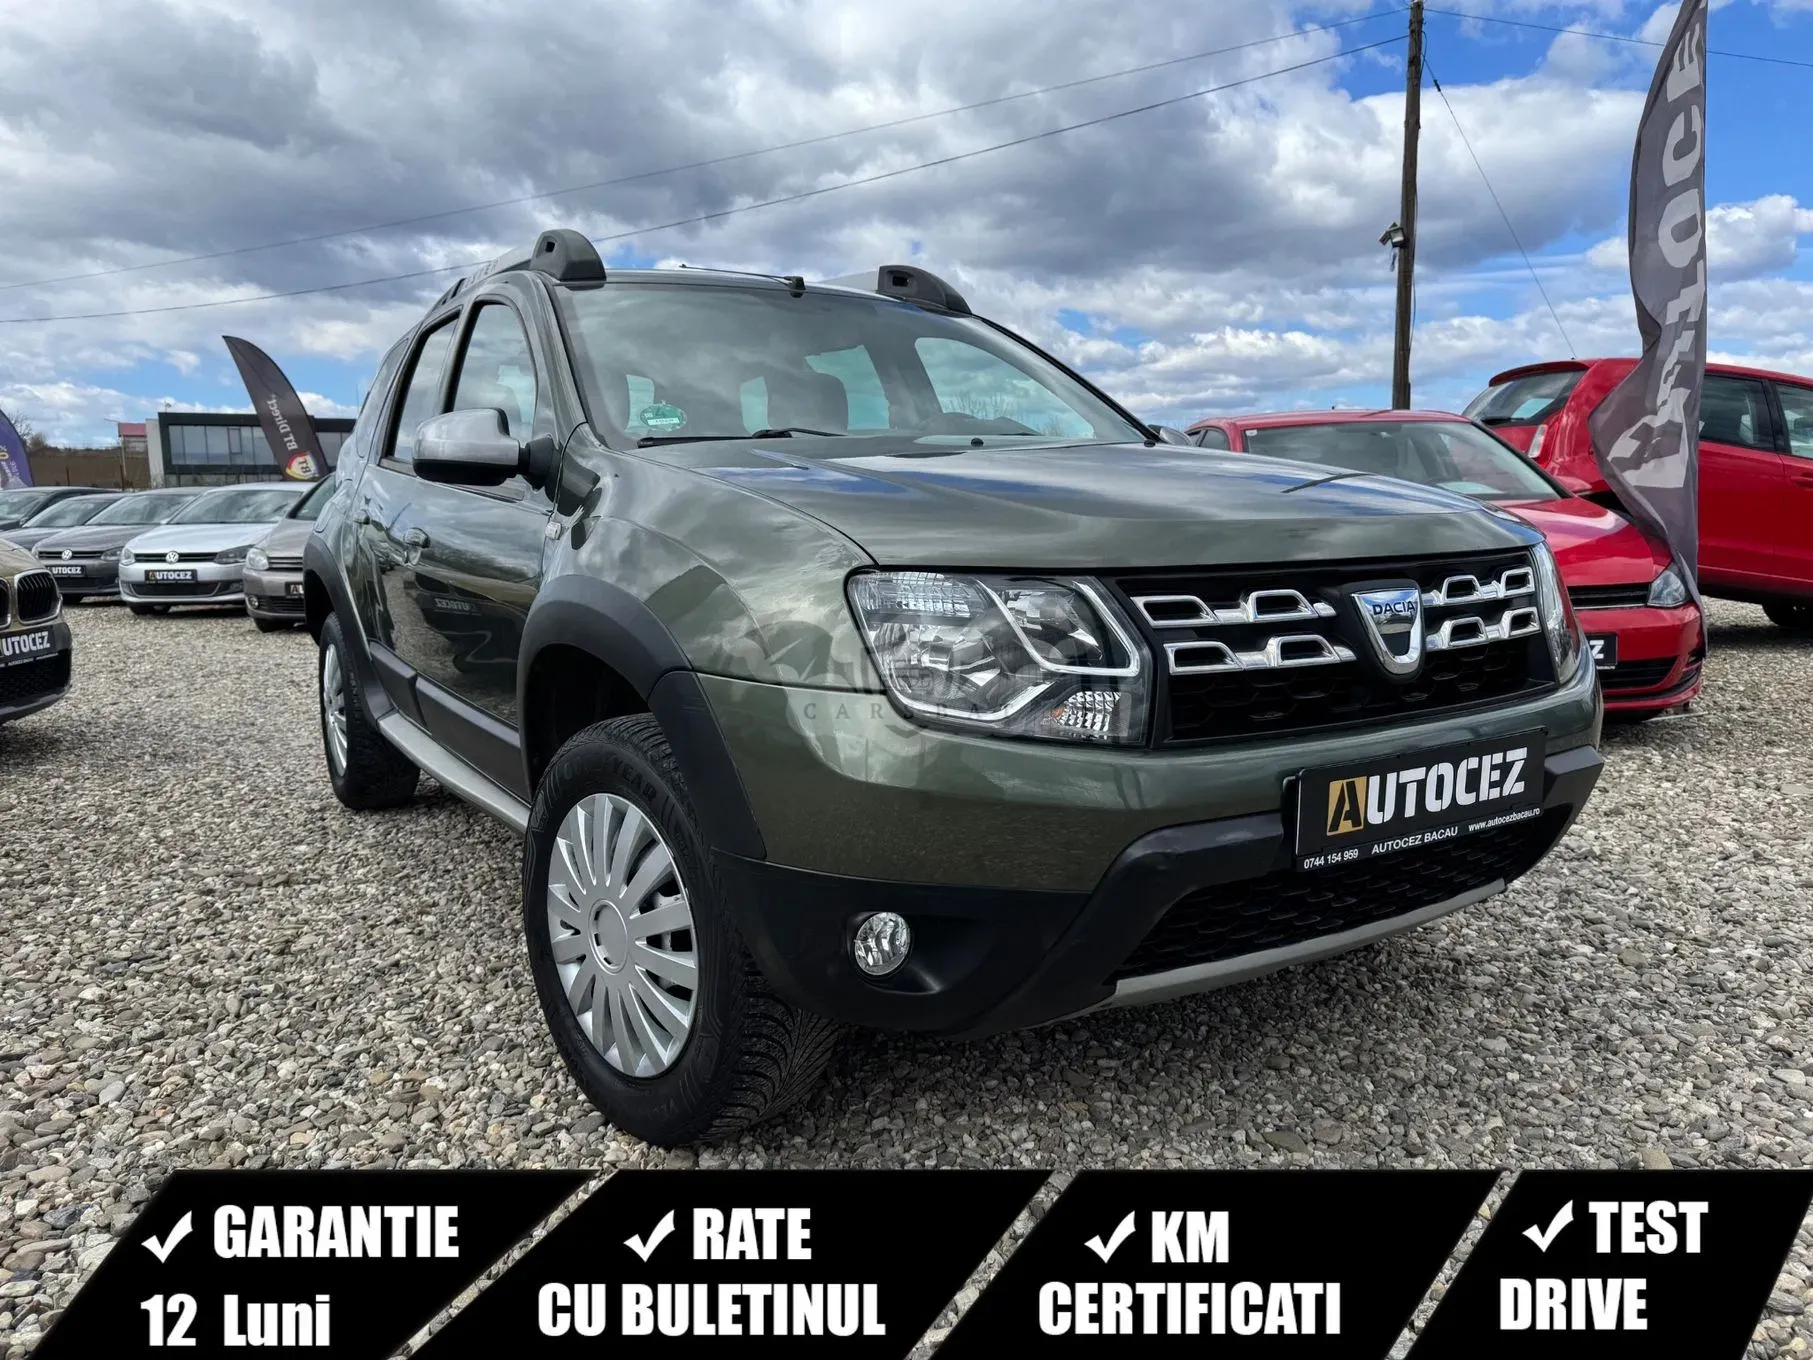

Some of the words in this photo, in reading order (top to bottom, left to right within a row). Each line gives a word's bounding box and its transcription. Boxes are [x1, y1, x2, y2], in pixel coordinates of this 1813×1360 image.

[1372, 600, 1416, 615] DACIA
[0, 631, 50, 656] UTOCEZ
[1326, 747, 1528, 836] AUTOCEZ
[1303, 855, 1325, 870] 0744
[1327, 851, 1341, 865] 154
[1343, 848, 1359, 861] 959
[1371, 834, 1423, 855] AUTOCEZ
[1424, 826, 1459, 843] BACAU
[1468, 807, 1541, 832] www.autocezbacau.ro
